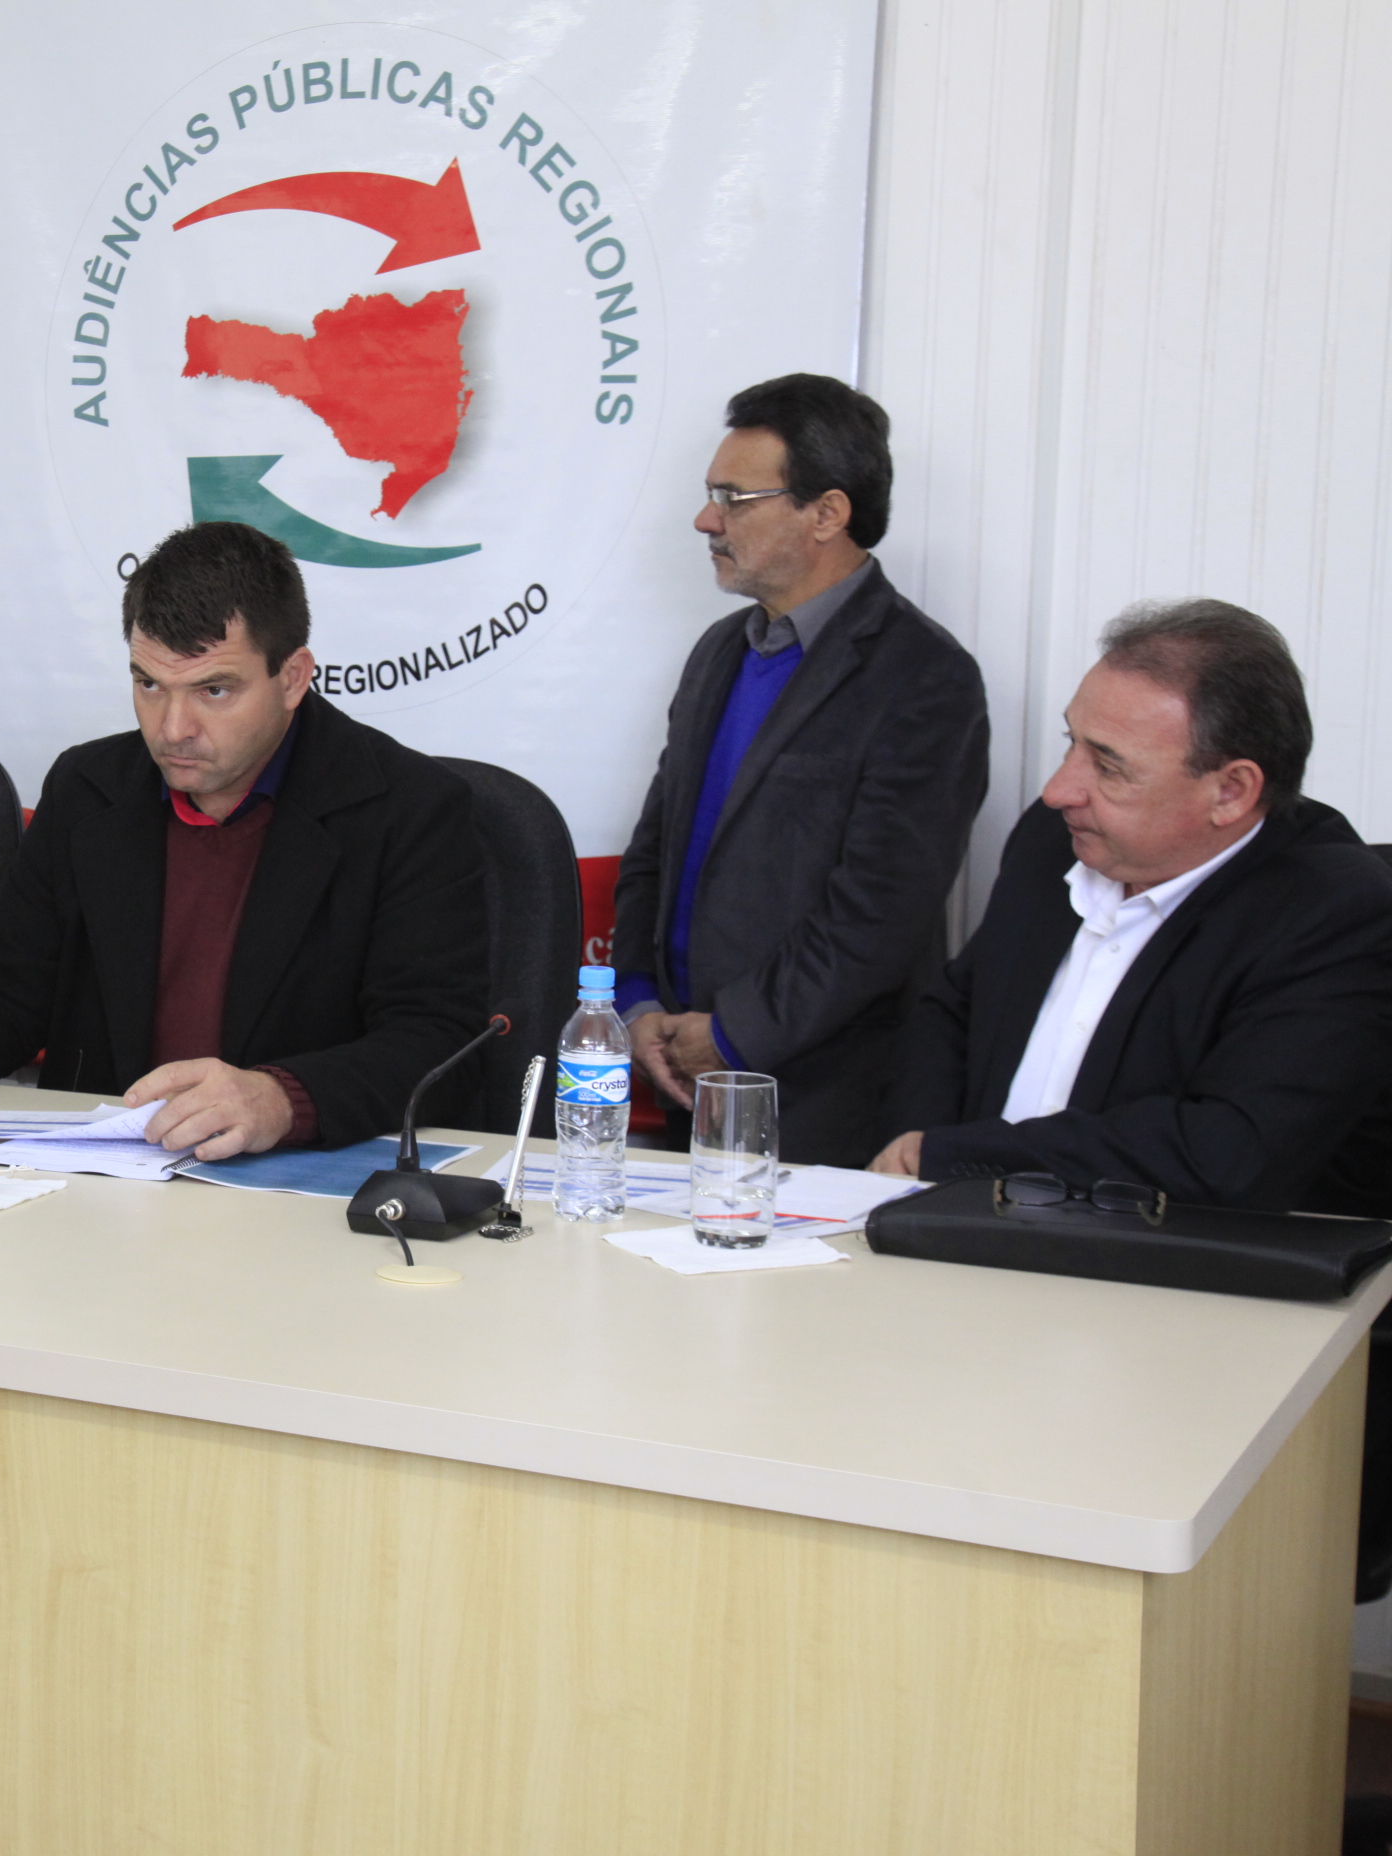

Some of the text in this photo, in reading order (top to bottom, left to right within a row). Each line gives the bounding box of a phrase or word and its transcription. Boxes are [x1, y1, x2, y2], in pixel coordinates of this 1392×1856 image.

[71, 57, 640, 428] AUDIÊNCIAS PÚBLICAS REGIONAIS
[310, 582, 549, 696] REGIONALIZADO
